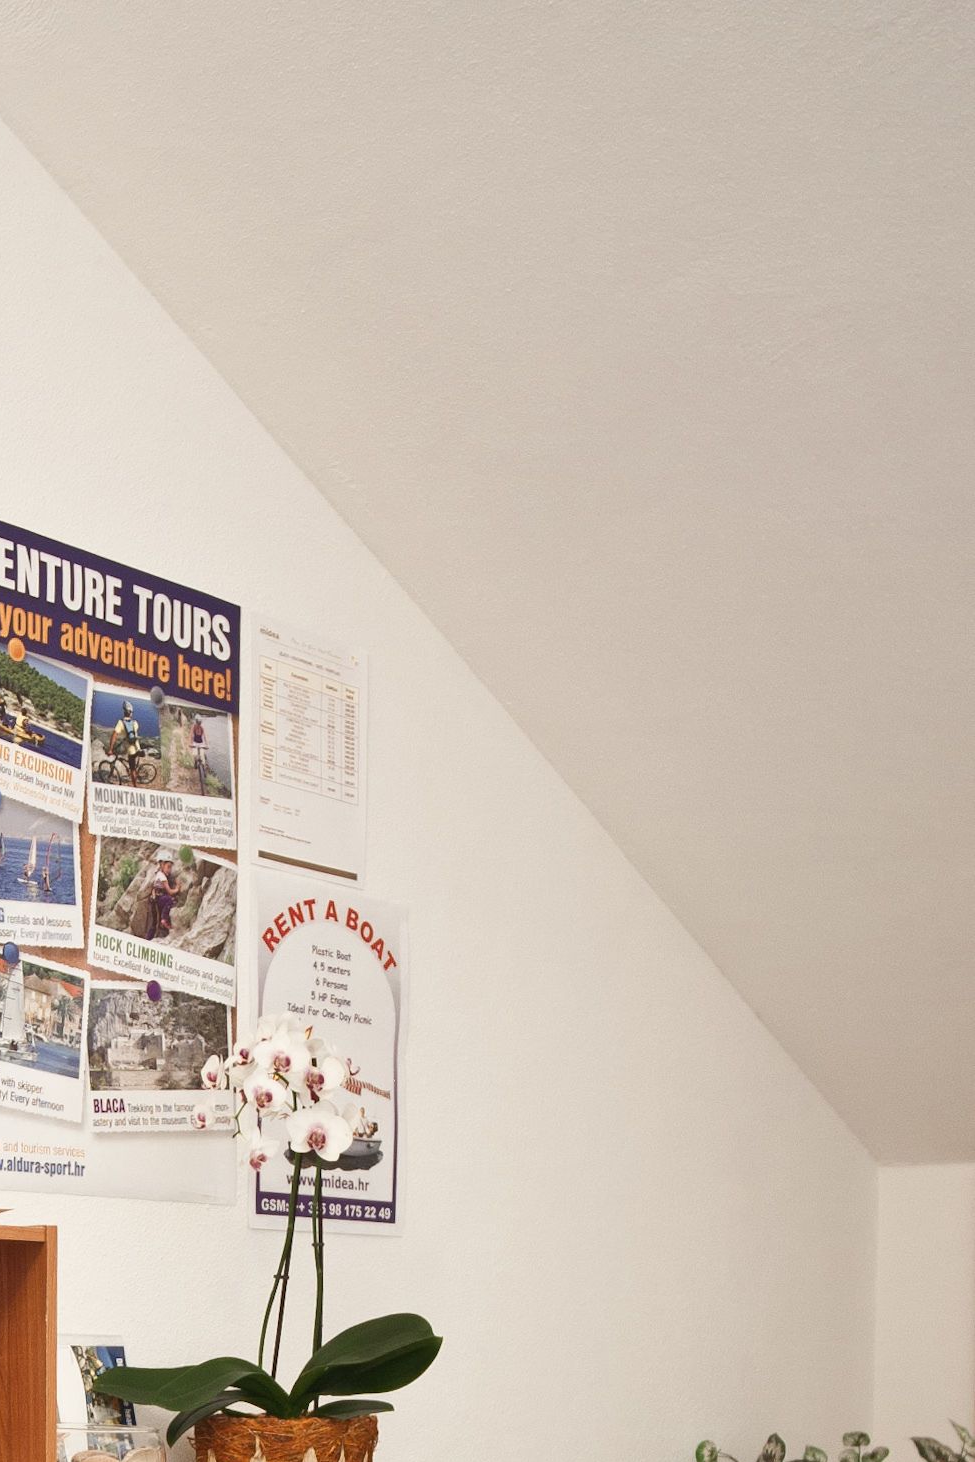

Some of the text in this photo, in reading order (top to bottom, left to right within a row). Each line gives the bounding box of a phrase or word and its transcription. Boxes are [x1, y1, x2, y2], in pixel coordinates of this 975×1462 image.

[133, 584, 231, 661] TOURS
[60, 621, 171, 683] adventure
[177, 653, 232, 701] here!
[15, 750, 73, 786] EXCURSION
[13, 768, 34, 783] hidden
[35, 776, 49, 790] bays
[51, 782, 62, 794] and
[64, 788, 75, 799] NW
[94, 787, 146, 808] MOUNTAIN
[150, 794, 183, 812] BIKING
[180, 822, 189, 831] the
[32, 916, 45, 926] and
[262, 898, 397, 971] RENT A BOAT
[95, 932, 122, 954] ROCK
[126, 941, 174, 969] CLIMBING
[202, 969, 213, 980] and
[311, 945, 352, 961] Plastic Boat
[327, 966, 351, 976] meters
[322, 978, 348, 991] Persons
[287, 1002, 305, 1014] Ideal
[330, 994, 351, 1008] Engine
[0, 1077, 16, 1088] with
[10, 1091, 30, 1106] Every
[31, 1096, 65, 1112] afternoon
[93, 1098, 126, 1113] BLACA
[155, 1104, 162, 1112] to
[163, 1103, 173, 1112] the
[2, 1142, 18, 1153] and
[21, 1142, 51, 1155] tourism
[52, 1146, 86, 1158] services
[261, 1198, 289, 1212] GSM:
[329, 1203, 341, 1216] 98
[345, 1204, 362, 1218] 175
[365, 1206, 376, 1218] 22
